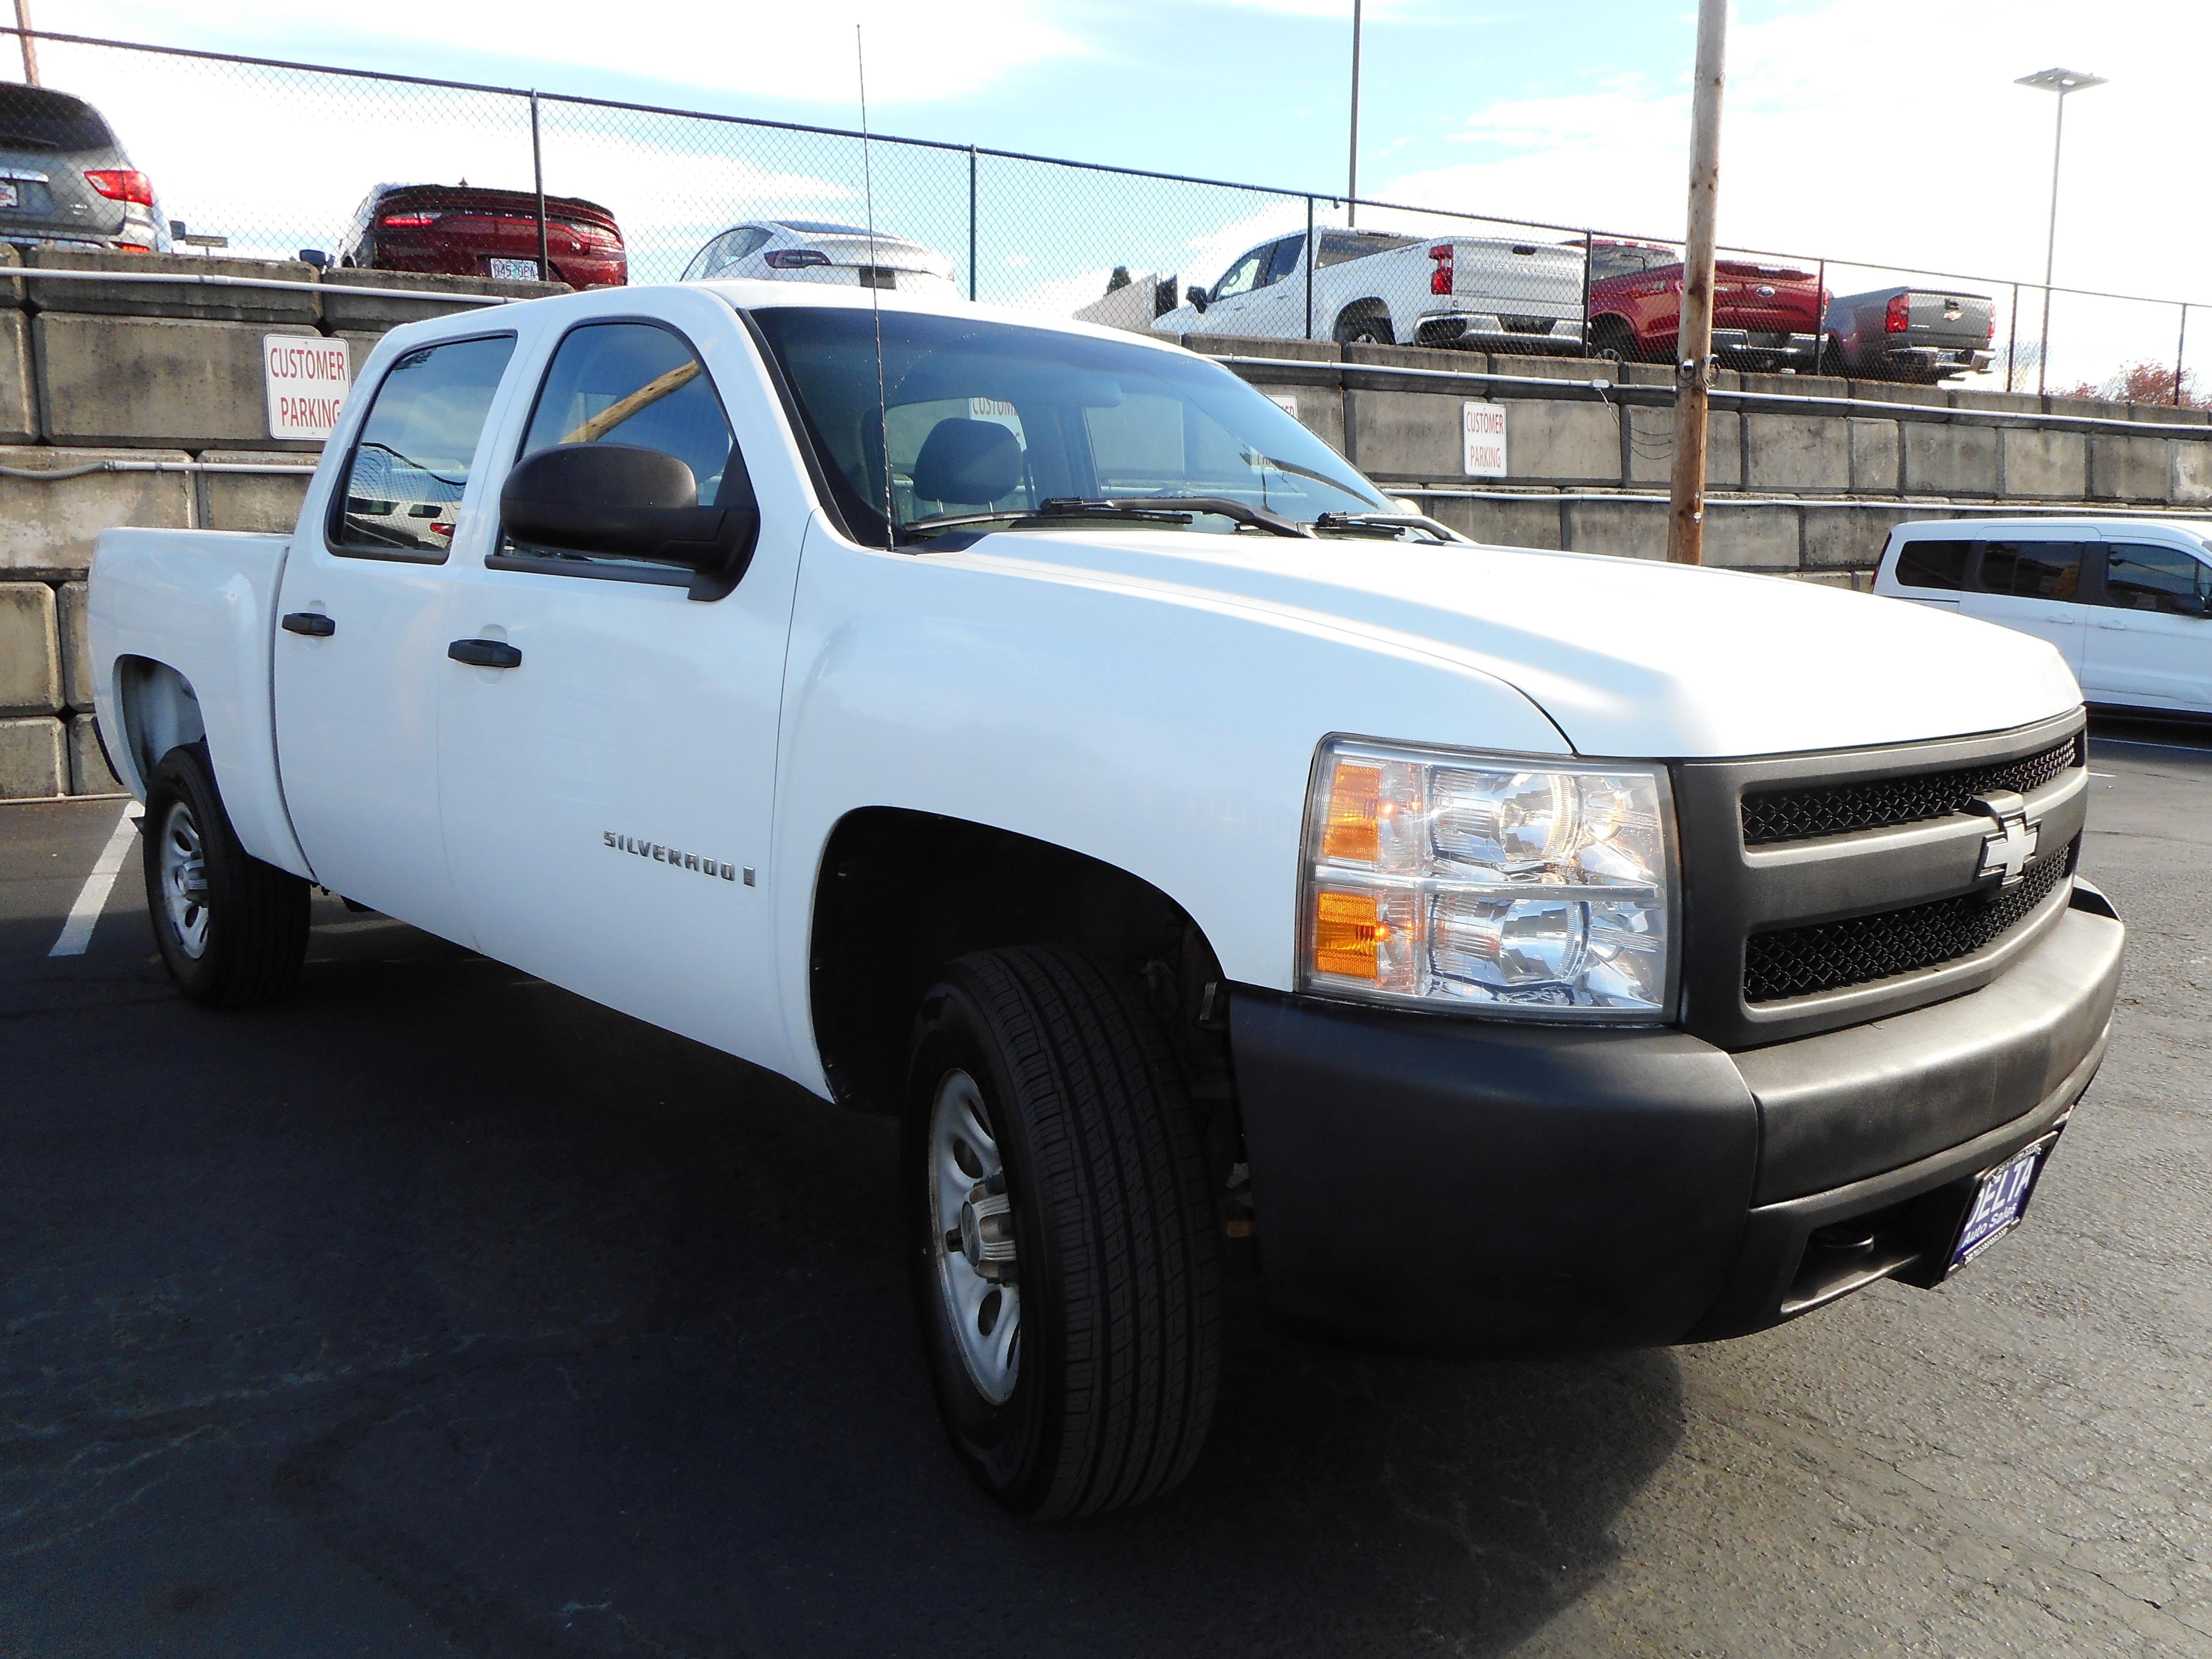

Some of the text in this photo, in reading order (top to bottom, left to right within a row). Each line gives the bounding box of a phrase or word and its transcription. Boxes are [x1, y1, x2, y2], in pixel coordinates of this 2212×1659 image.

[270, 348, 346, 380] CUSTOMER
[281, 397, 341, 428] PARKING
[972, 398, 1018, 416] CUSTOM
[1467, 411, 1504, 434] CUSTOMER
[1471, 446, 1501, 468] PARKING
[604, 830, 735, 881] SILVERADO
[1961, 1223, 1988, 1248] Auto
[1989, 1203, 2017, 1228] Sales
